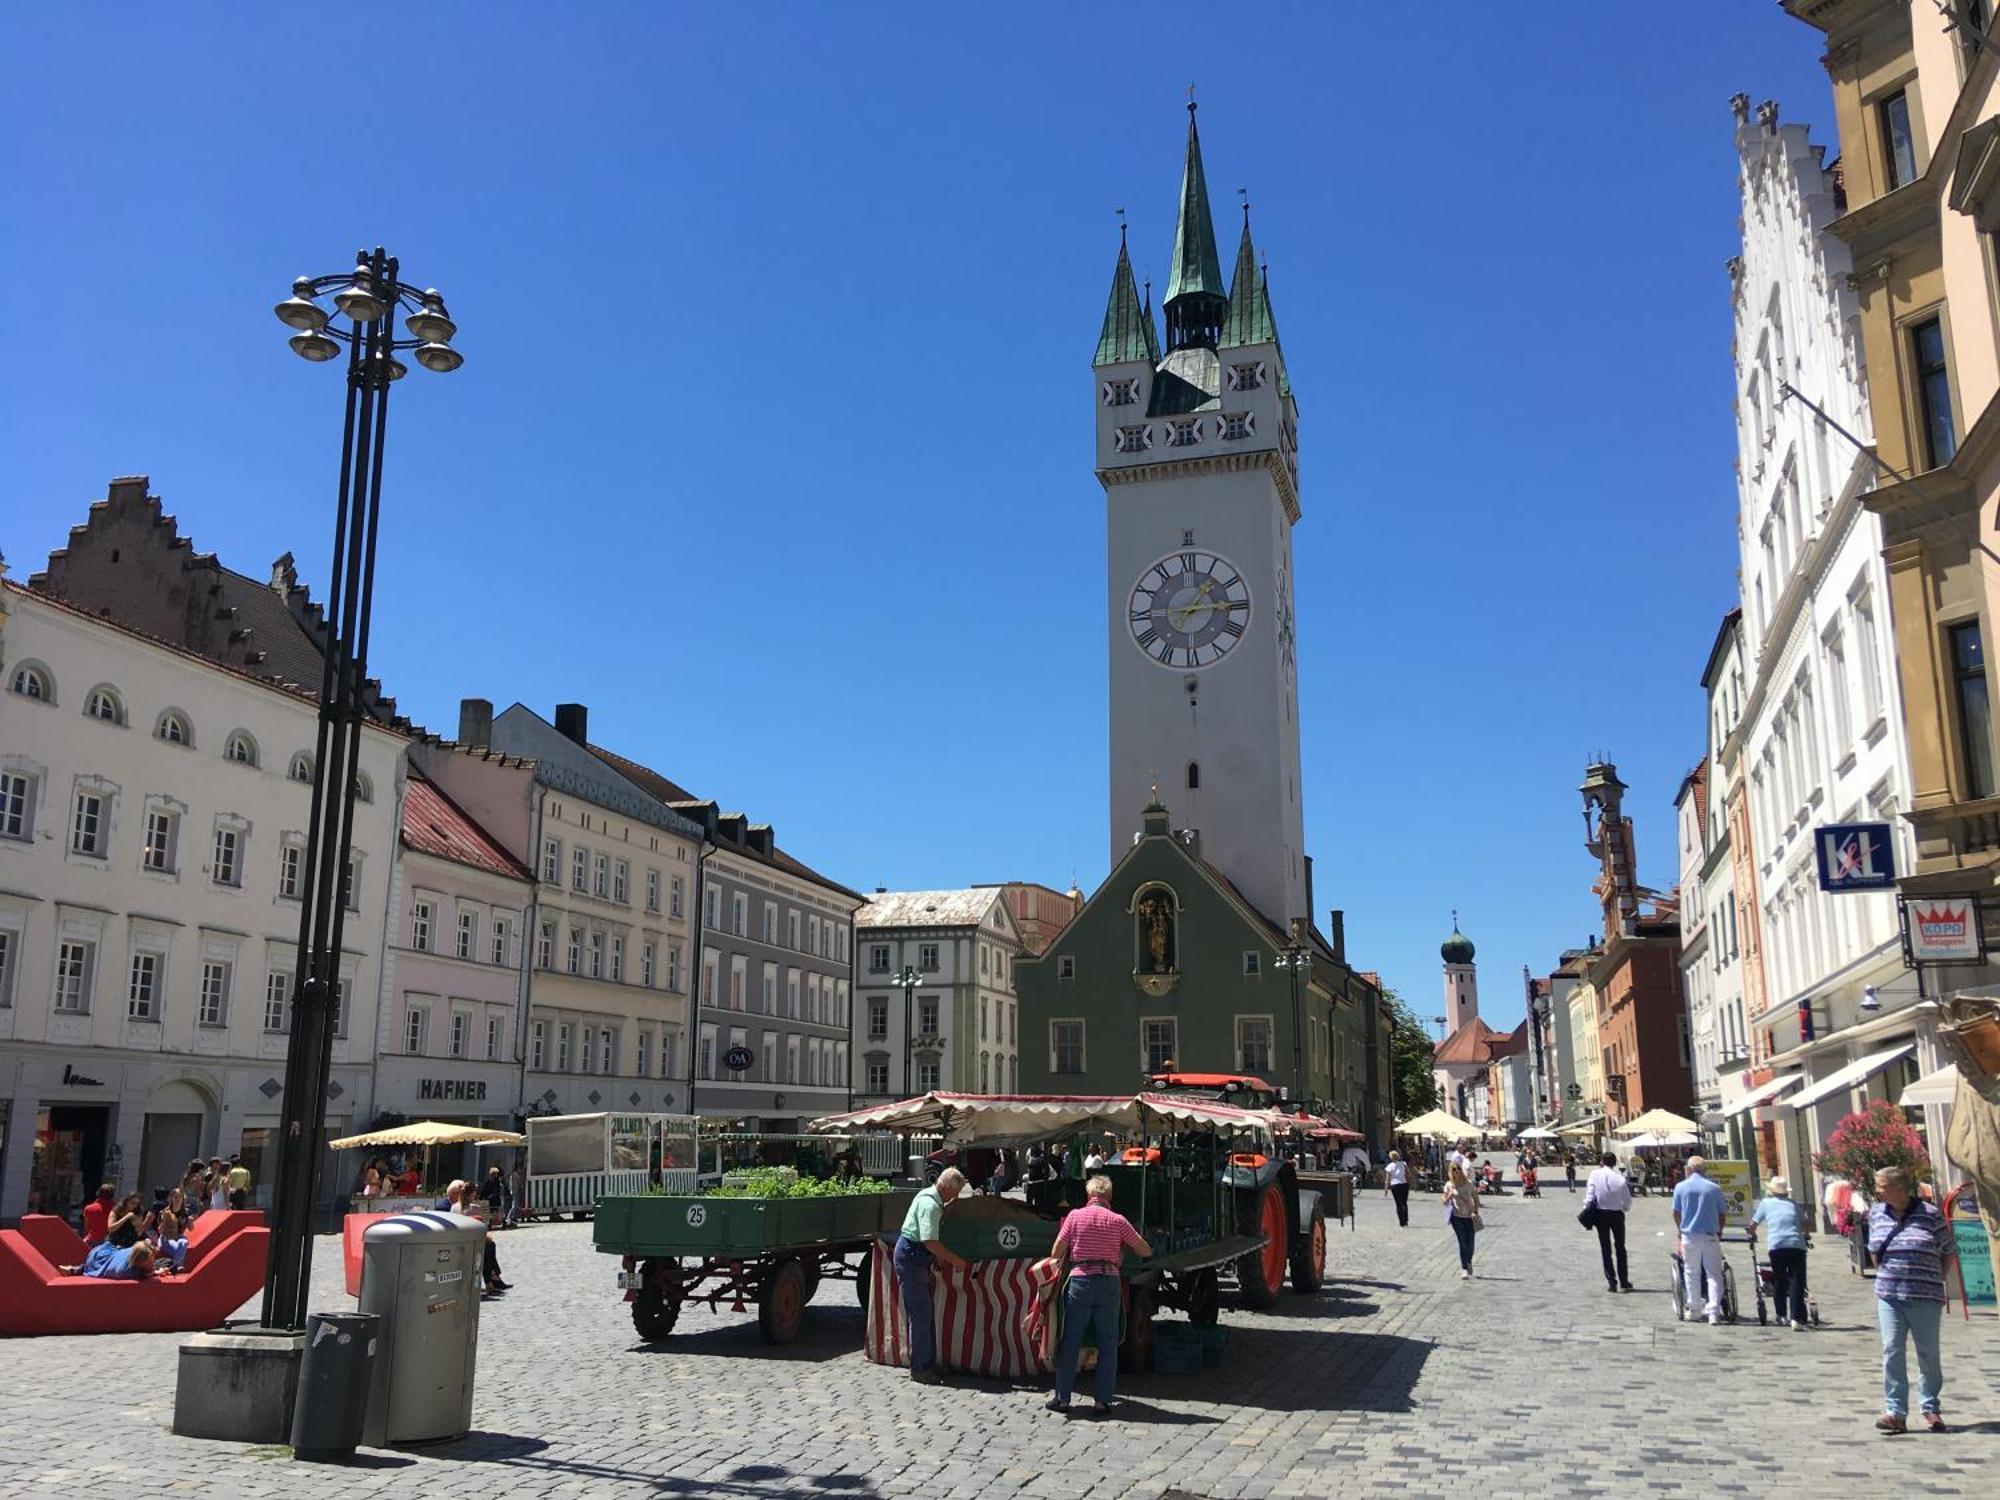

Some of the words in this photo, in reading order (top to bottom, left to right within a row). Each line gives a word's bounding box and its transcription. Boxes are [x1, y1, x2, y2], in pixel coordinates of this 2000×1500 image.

[420, 1078, 487, 1101] HAFNER
[690, 1207, 703, 1224] 25
[1002, 1228, 1017, 1246] 25
